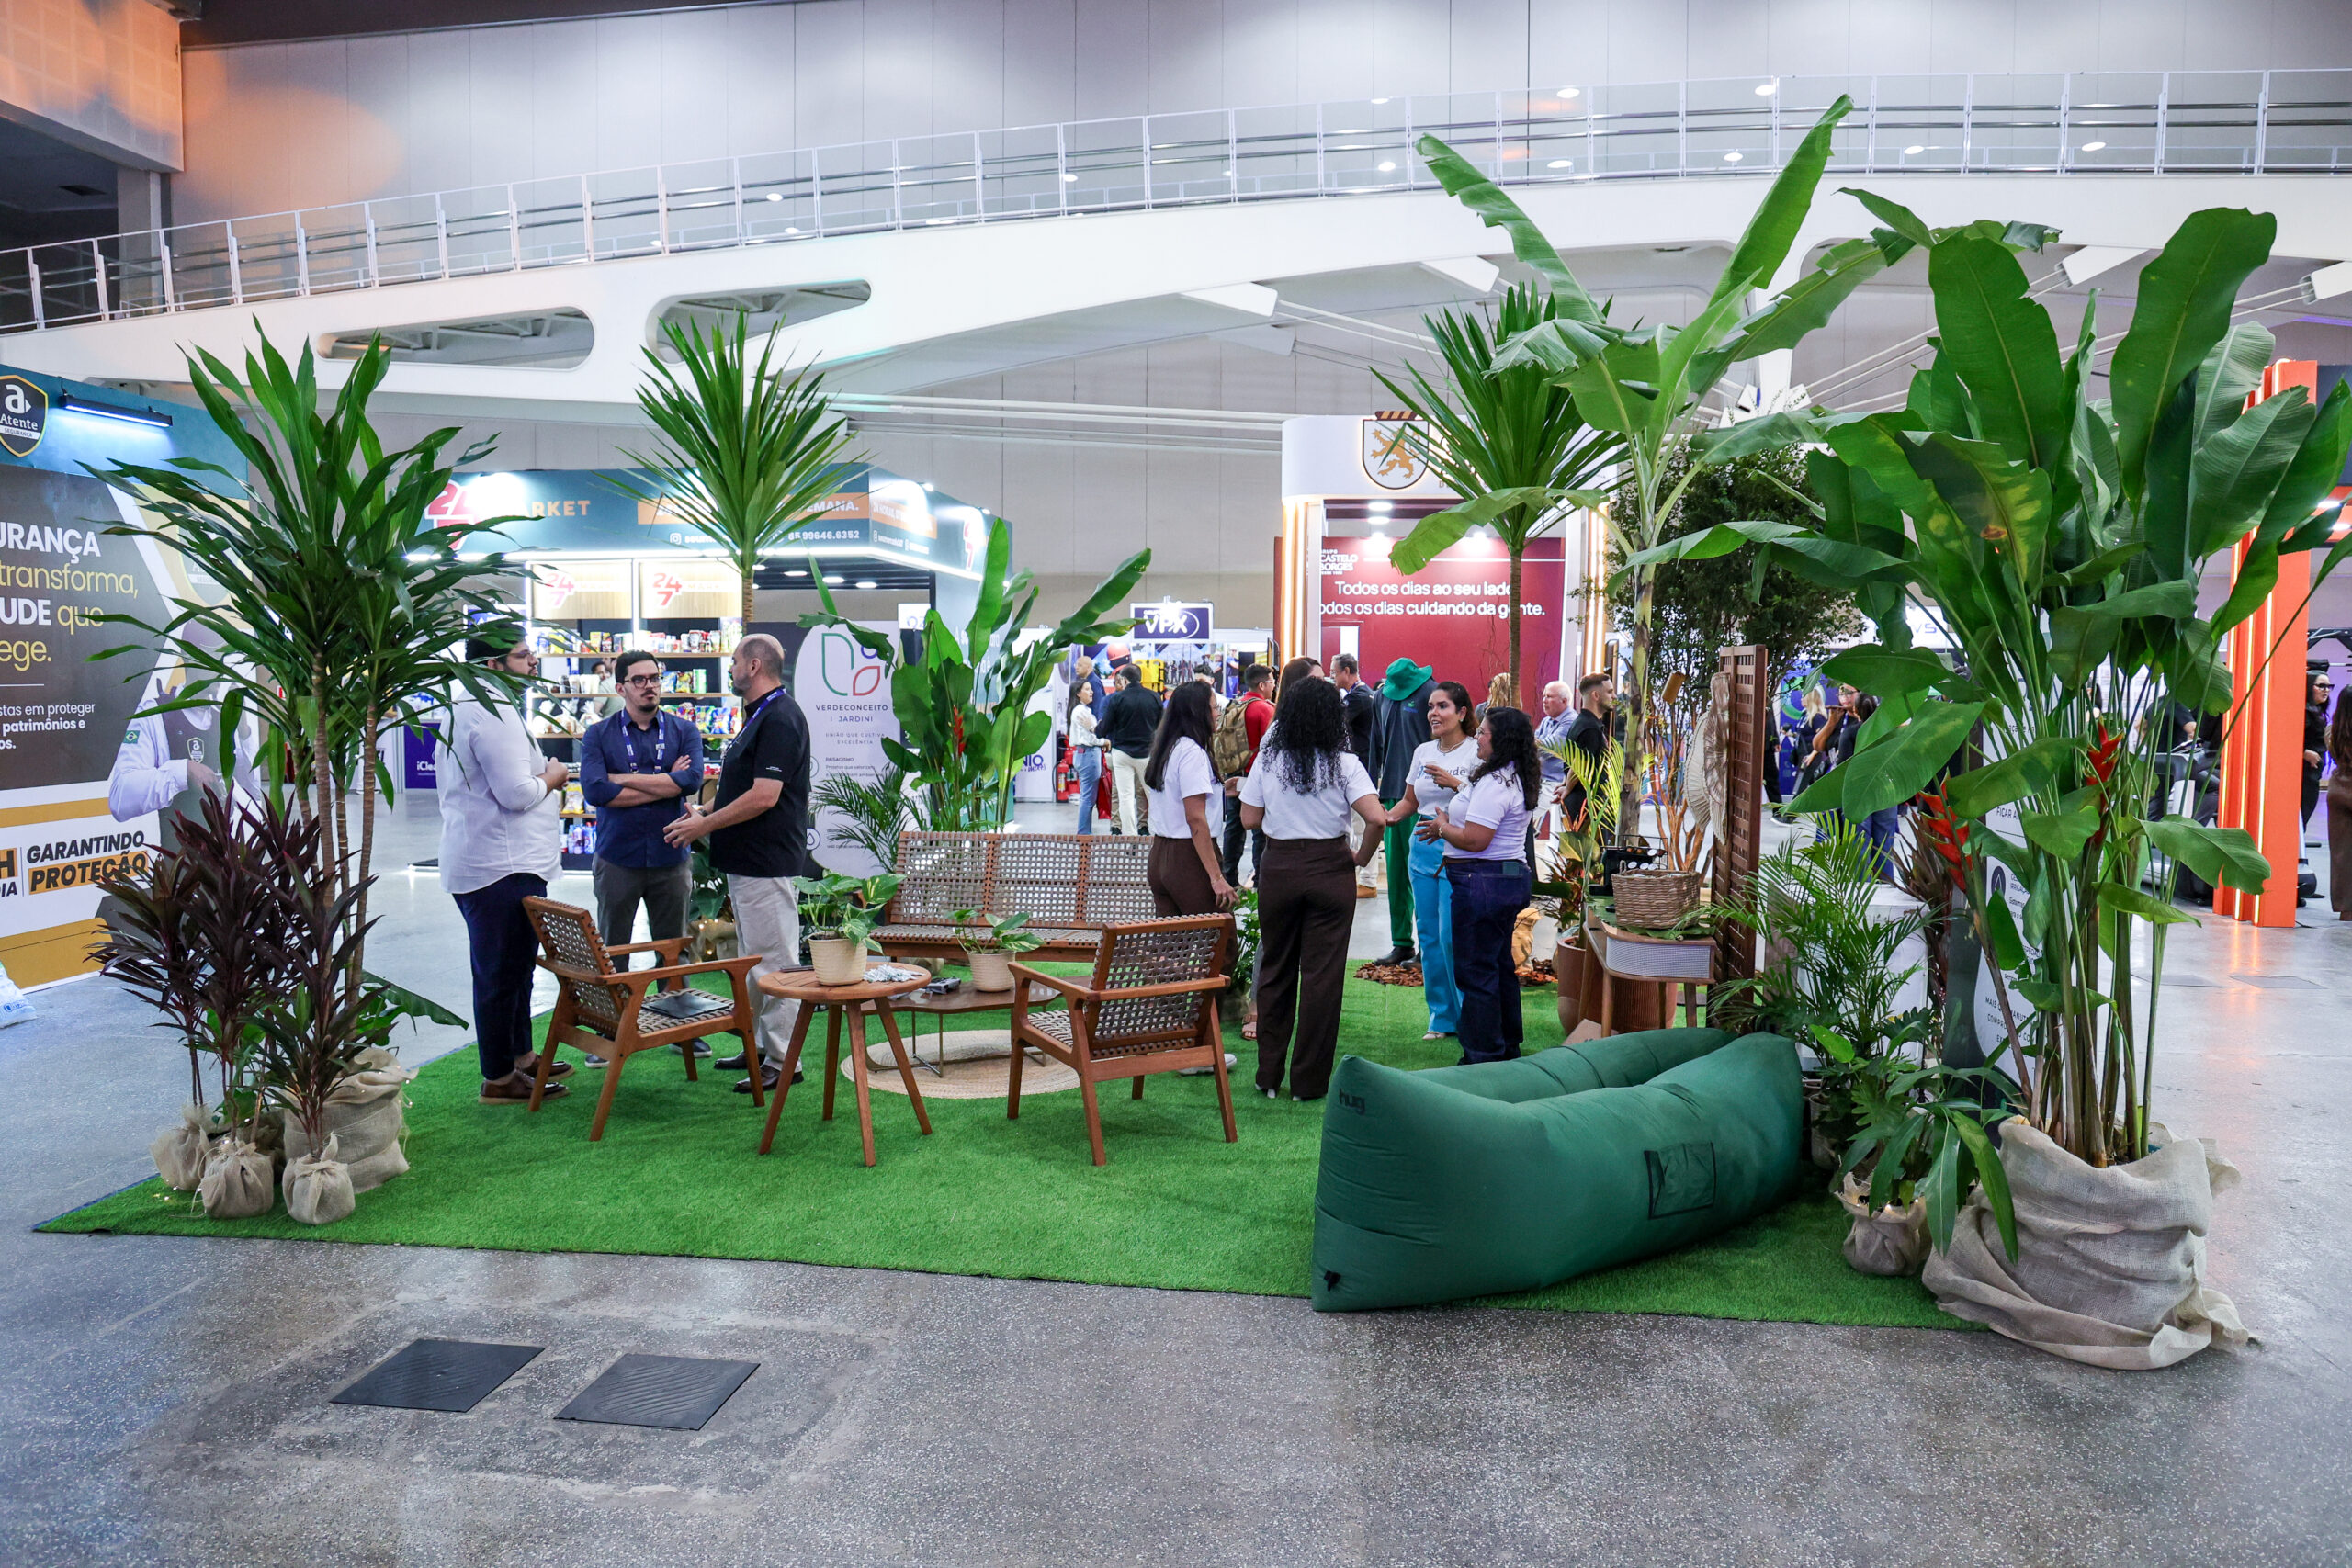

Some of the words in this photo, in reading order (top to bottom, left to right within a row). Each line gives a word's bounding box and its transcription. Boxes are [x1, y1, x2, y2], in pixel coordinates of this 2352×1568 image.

[0, 413, 39, 430] Atente
[803, 530, 860, 540] 99646.6352
[1321, 554, 1359, 563] CASTELO
[0, 560, 138, 599] transforma,
[1334, 581, 1379, 595] Todos
[1381, 583, 1399, 595] os
[1401, 581, 1430, 595] dias
[1432, 584, 1452, 595] ao
[1453, 584, 1481, 595] seu
[1320, 601, 1352, 615] odos
[1354, 604, 1373, 615] os
[1374, 601, 1404, 615] dias
[1406, 601, 1476, 615] cuidando
[1477, 601, 1497, 615] da
[1498, 602, 1545, 619] gnte.
[25, 705, 44, 716] em
[48, 703, 96, 717] proteger
[3, 718, 76, 736] patrimônios
[79, 720, 86, 729] e
[27, 830, 145, 864] GARANTINDO
